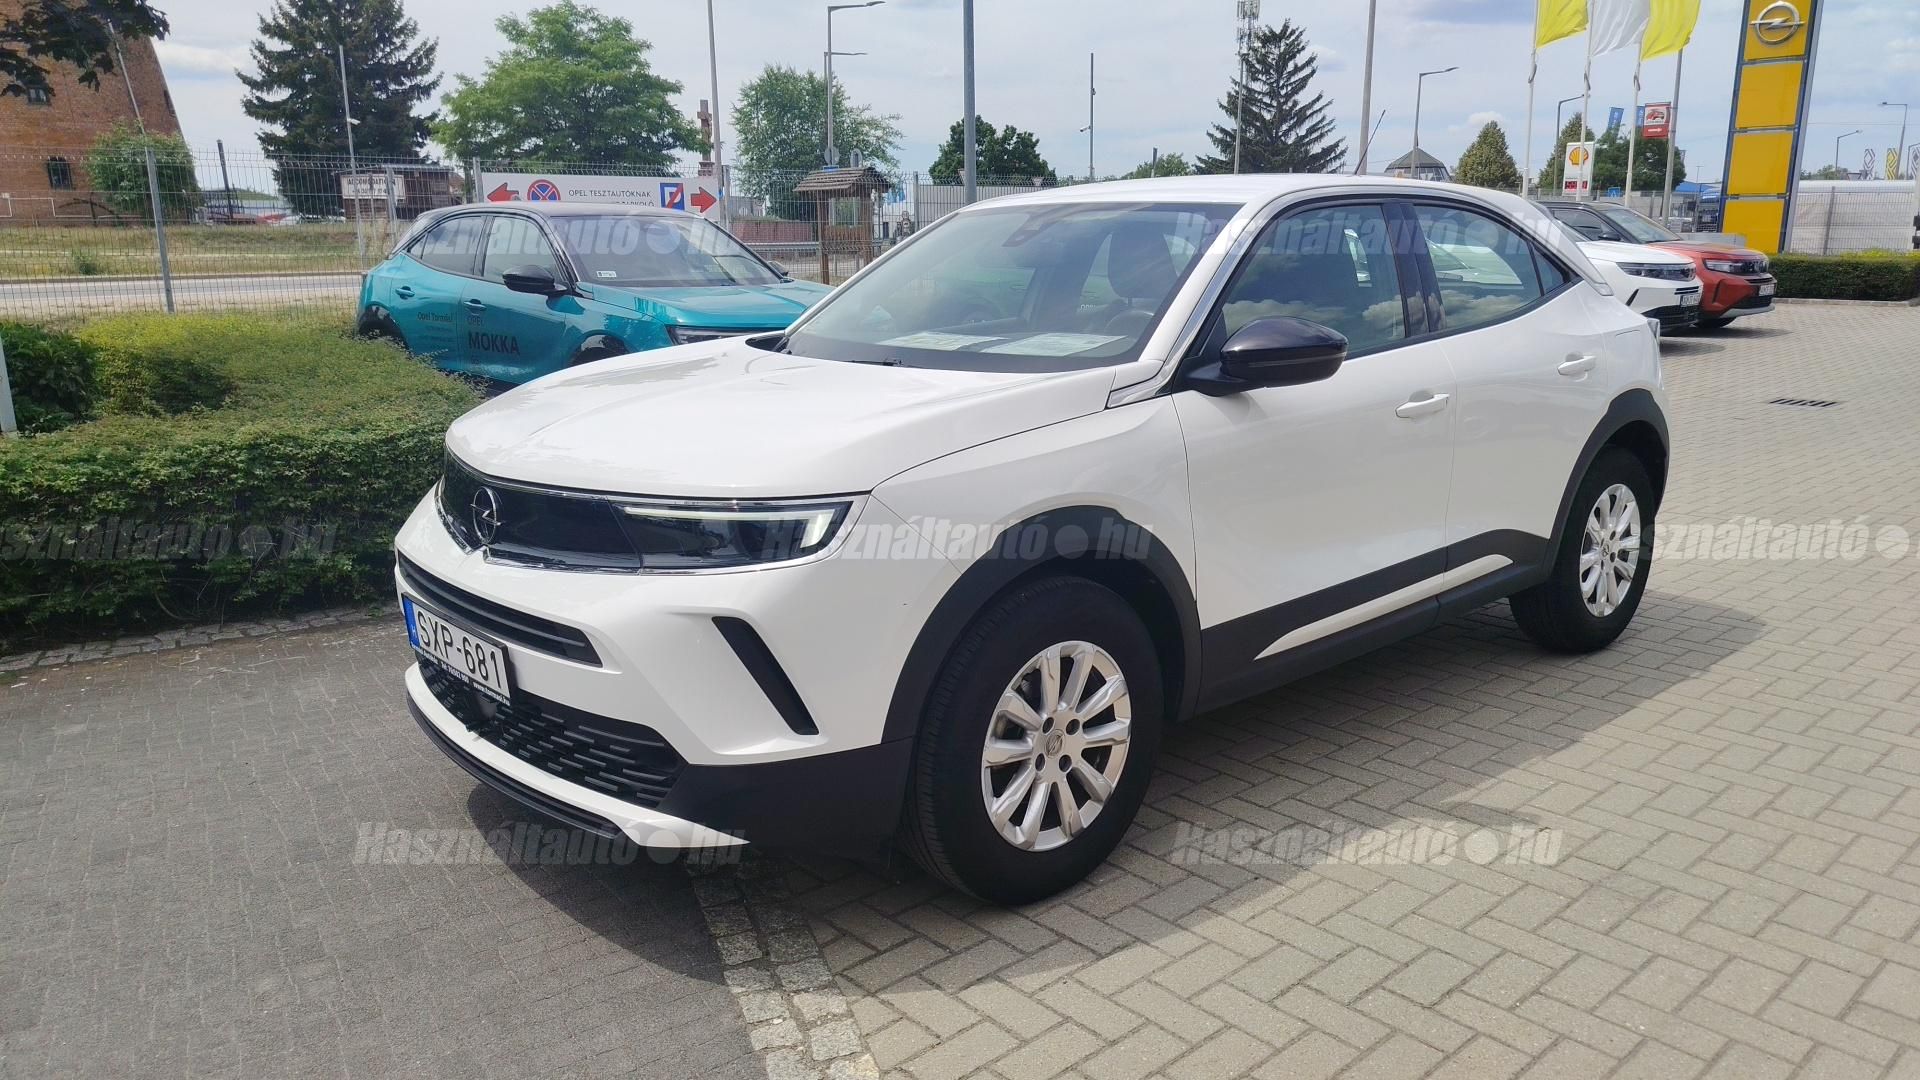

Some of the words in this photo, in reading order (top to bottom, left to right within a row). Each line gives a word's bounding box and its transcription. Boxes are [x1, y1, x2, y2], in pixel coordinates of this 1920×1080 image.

[568, 189, 588, 197] OPEL
[467, 330, 521, 356] MOKKA
[417, 610, 502, 690] SXP-681
